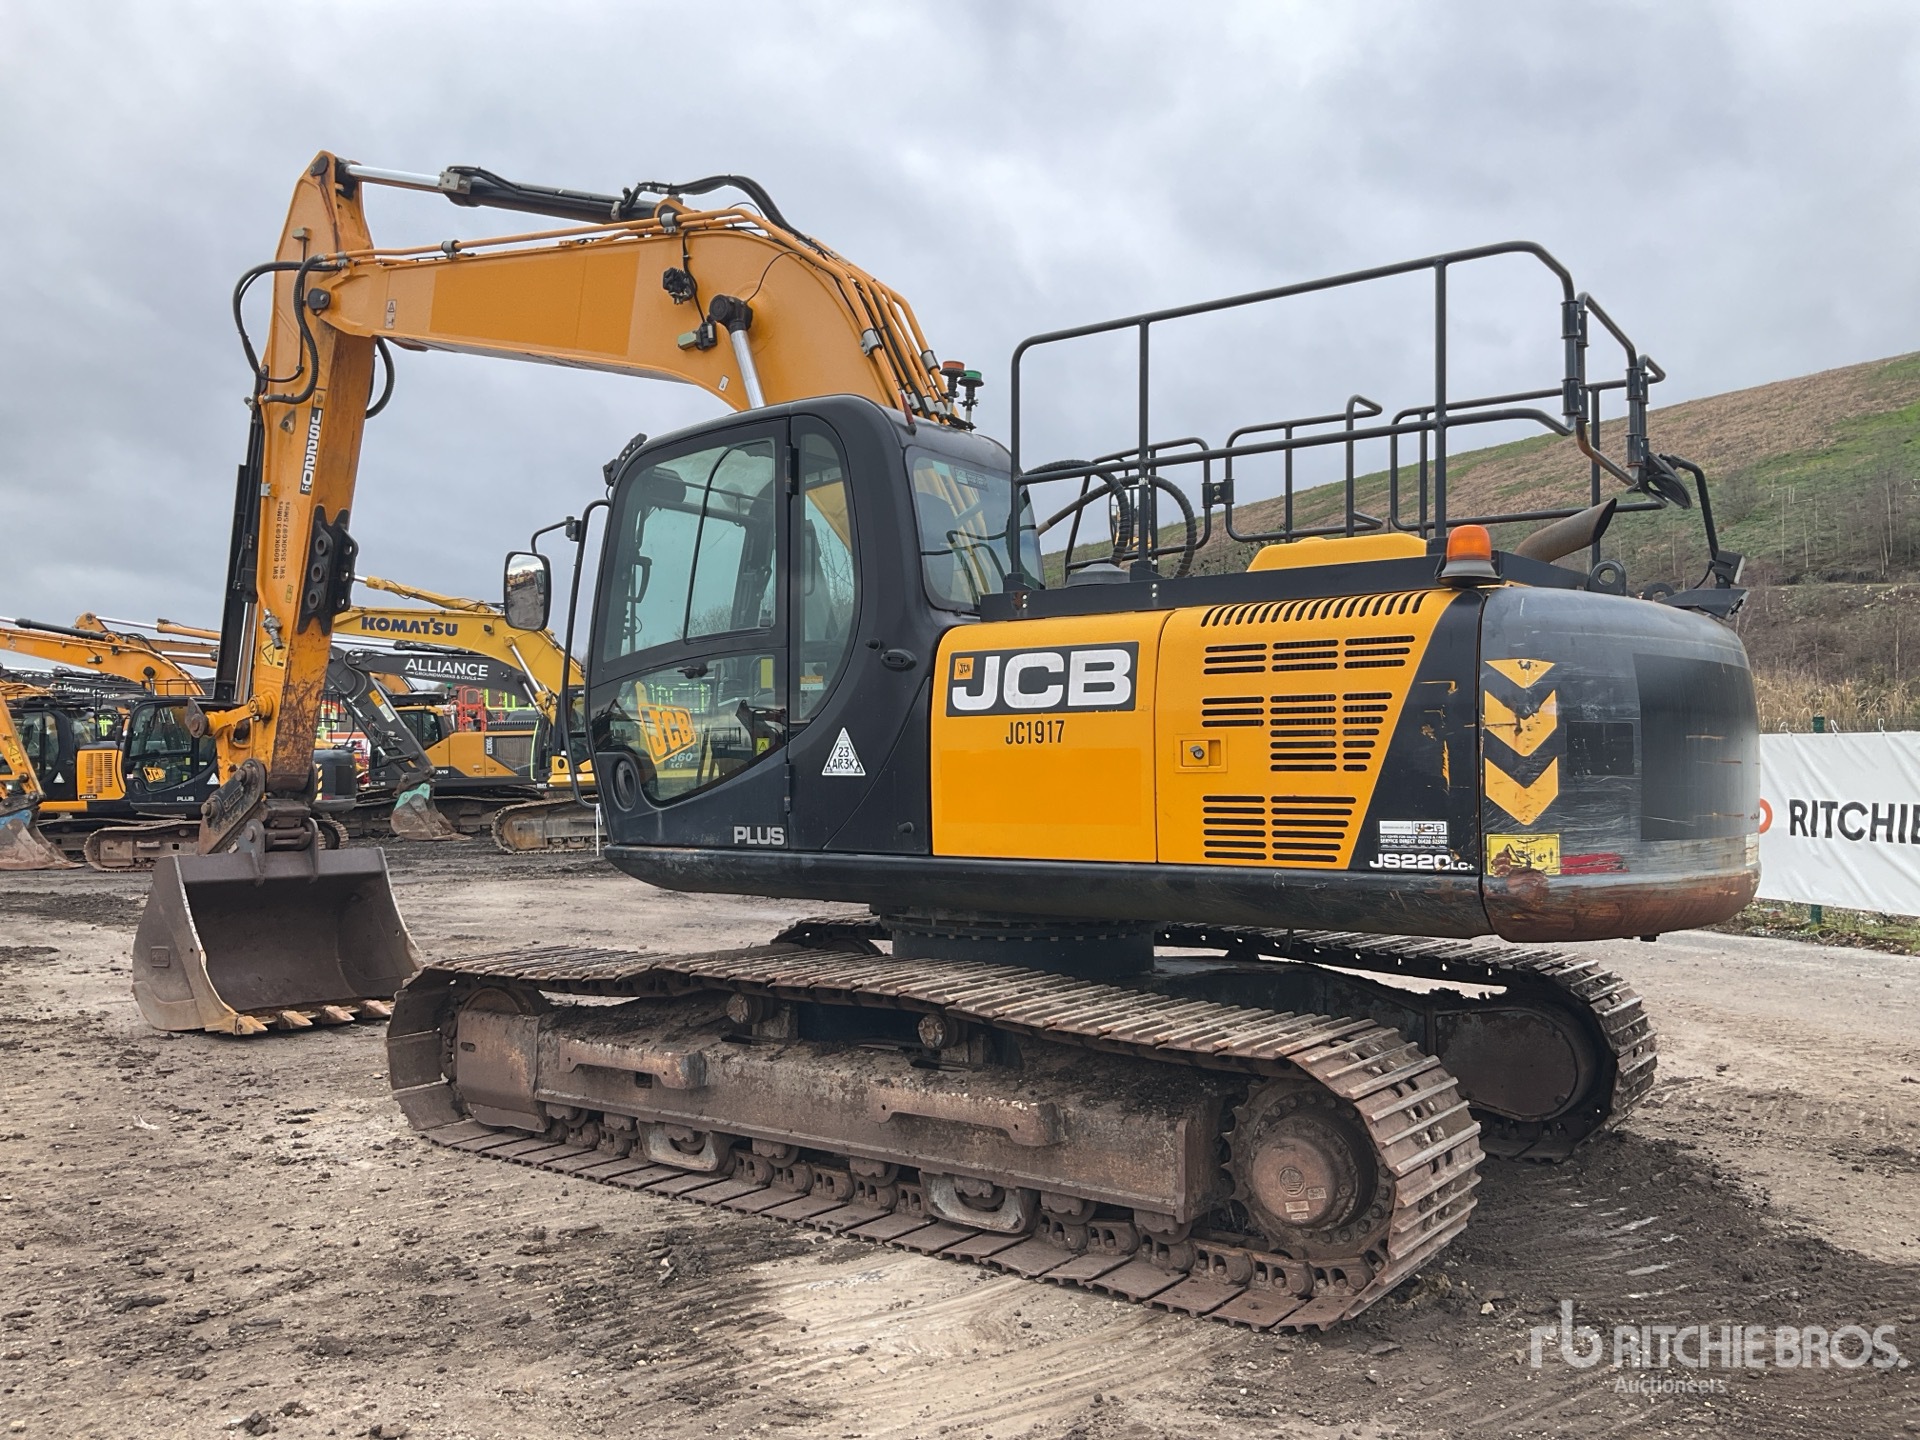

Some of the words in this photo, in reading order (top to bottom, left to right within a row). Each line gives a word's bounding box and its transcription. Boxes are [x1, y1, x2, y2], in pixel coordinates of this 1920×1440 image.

[361, 616, 459, 637] KOMATSU
[404, 658, 489, 677] ALLIANCE
[414, 671, 456, 680] GROUNDWORKS
[952, 649, 1132, 711] JCB
[648, 708, 692, 757] JCB
[1005, 720, 1065, 745] JC1917
[838, 746, 850, 758] 23
[832, 758, 855, 770] AR3K
[733, 826, 785, 845] PLUS
